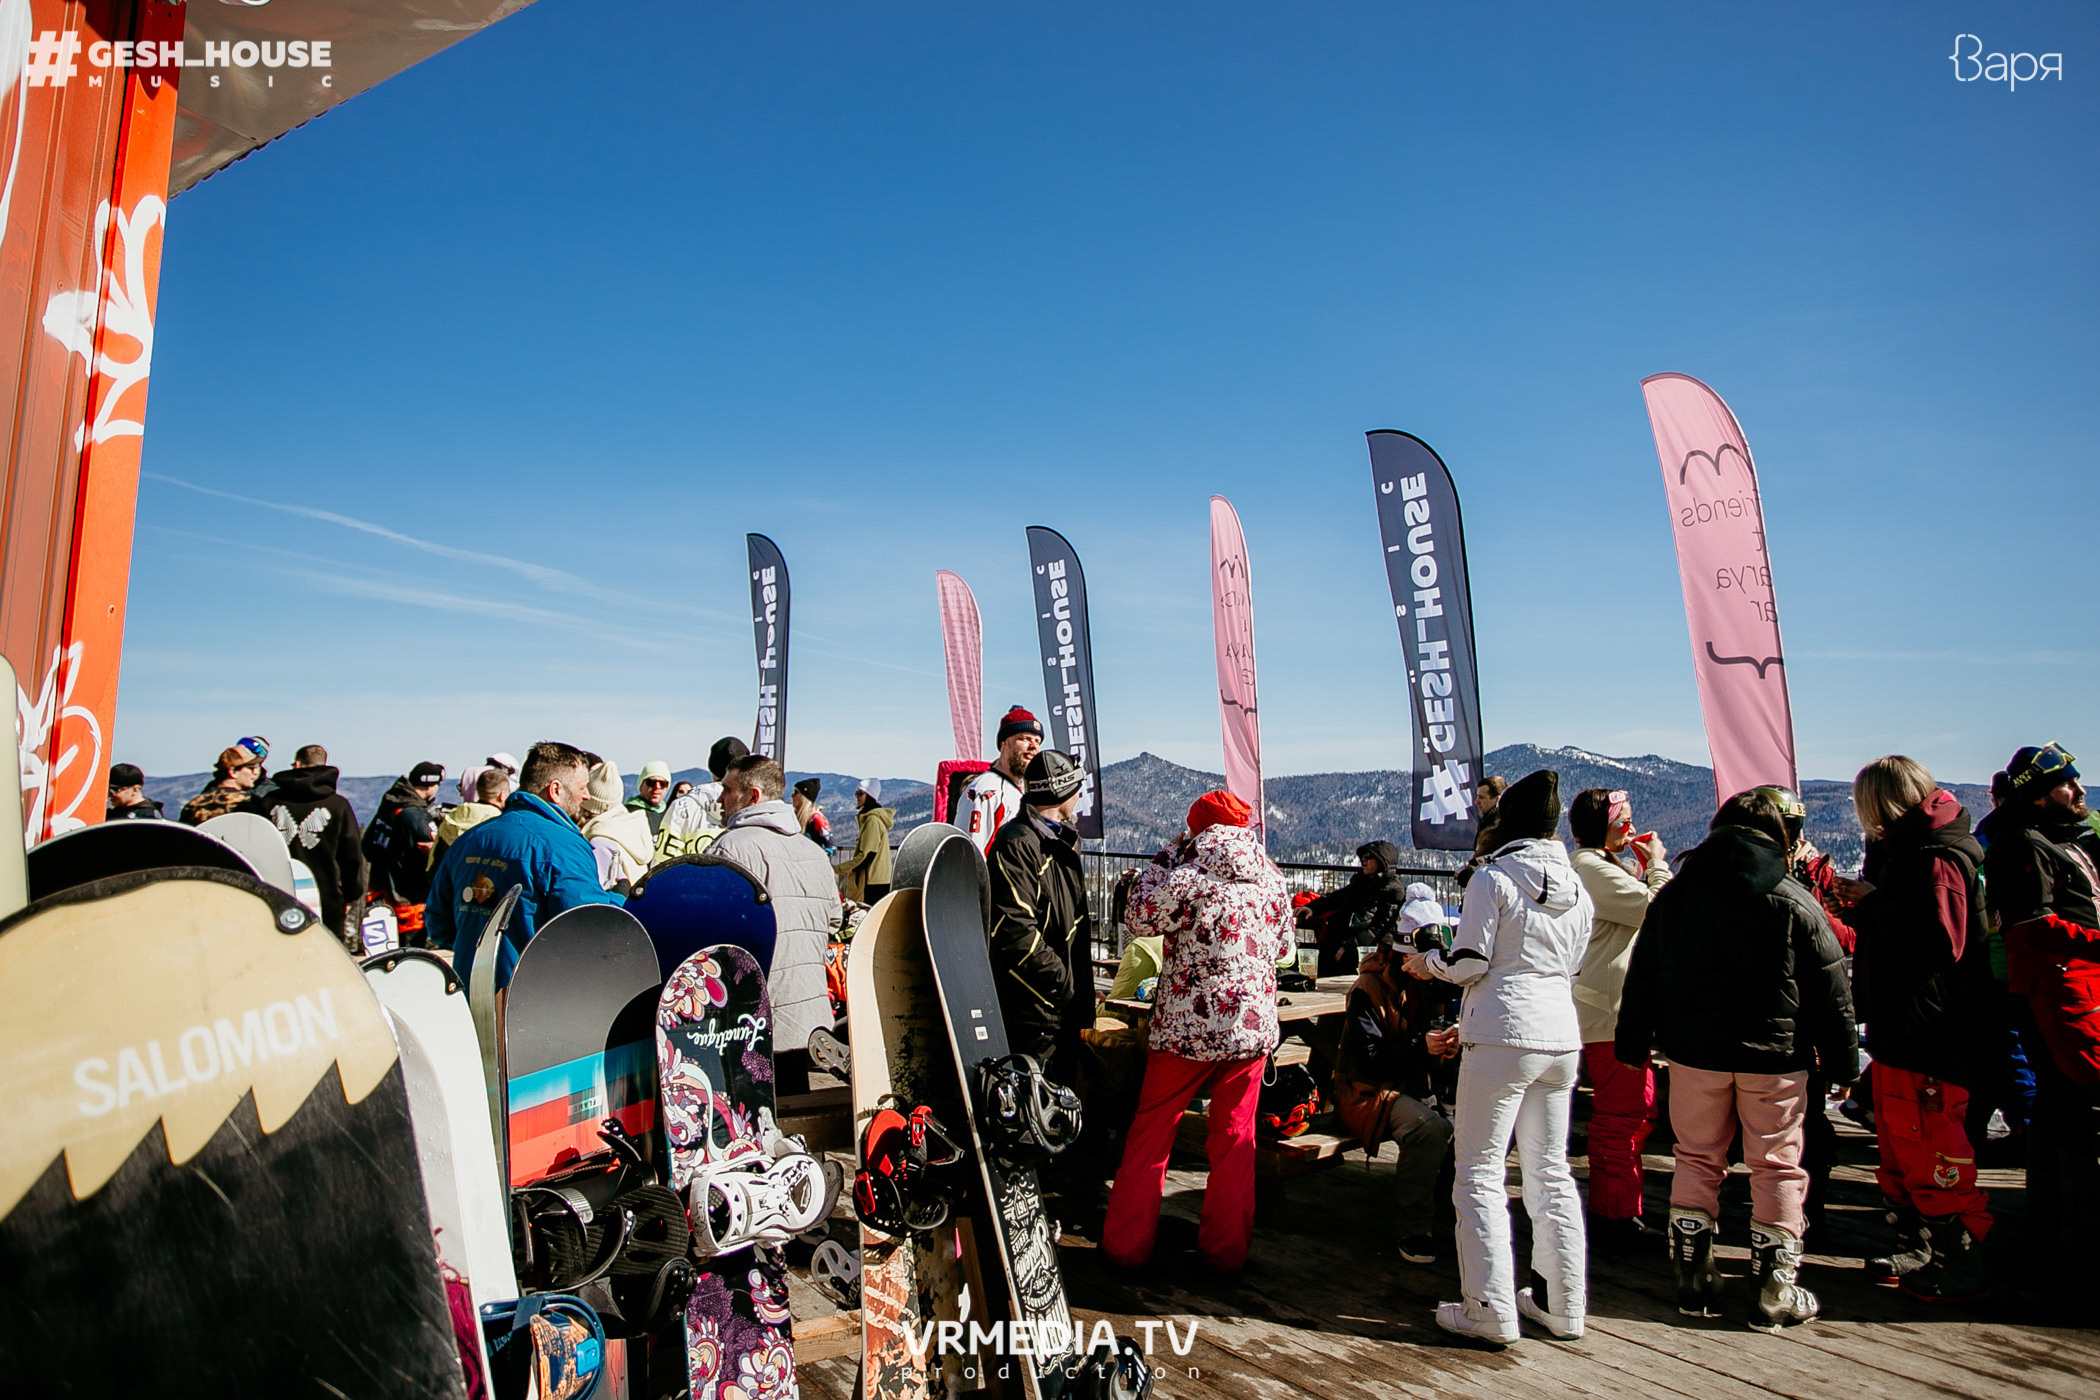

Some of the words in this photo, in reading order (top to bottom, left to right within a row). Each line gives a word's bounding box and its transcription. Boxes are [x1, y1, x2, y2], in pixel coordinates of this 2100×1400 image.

[1029, 773, 1076, 790] SWNS
[73, 988, 341, 1118] SALOMON
[686, 1013, 767, 1056] Lunatique
